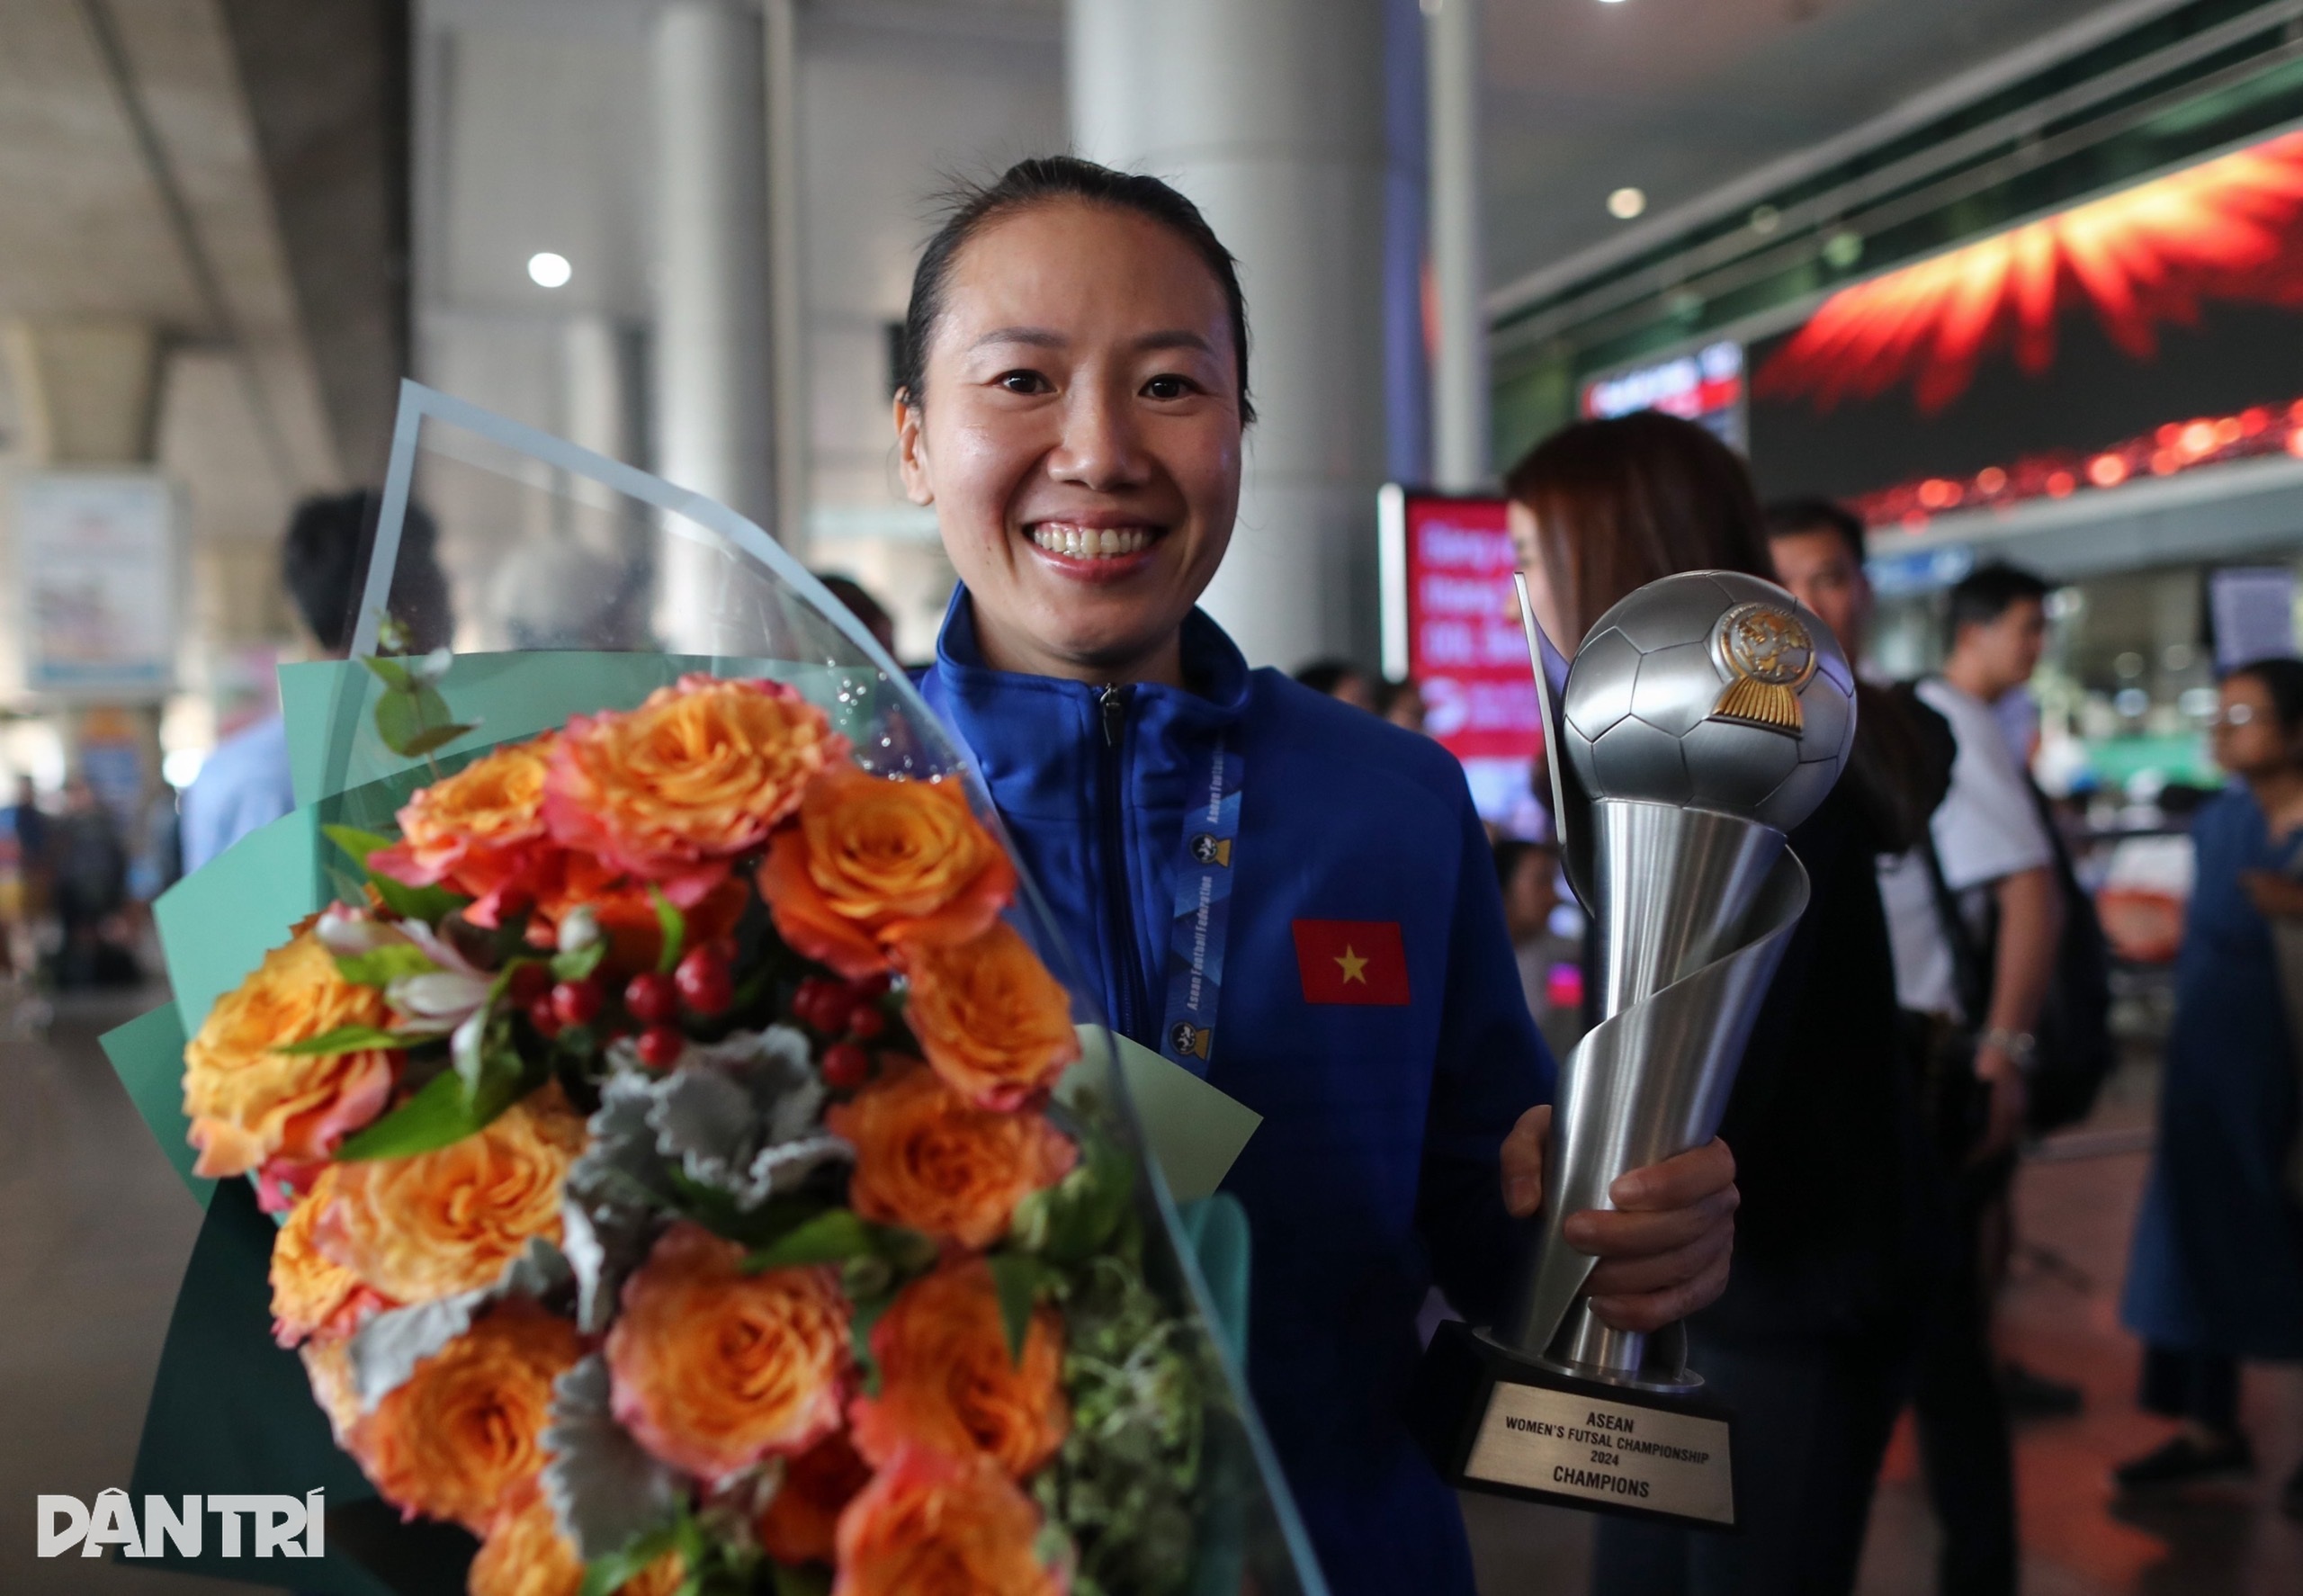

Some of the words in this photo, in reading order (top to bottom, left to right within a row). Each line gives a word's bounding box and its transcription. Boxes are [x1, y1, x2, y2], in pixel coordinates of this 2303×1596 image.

[1195, 875, 1213, 932] Federation
[1190, 933, 1206, 976] Football
[1187, 977, 1201, 1011] Asean
[1586, 1412, 1634, 1433] ASEAN
[1505, 1416, 1564, 1439] WOMEN'S
[1568, 1429, 1613, 1448] FUTSAL
[1616, 1438, 1709, 1465] CHAMPIONSHIP
[1590, 1450, 1619, 1466] 2024
[1553, 1466, 1650, 1498] CHAMPIONS
